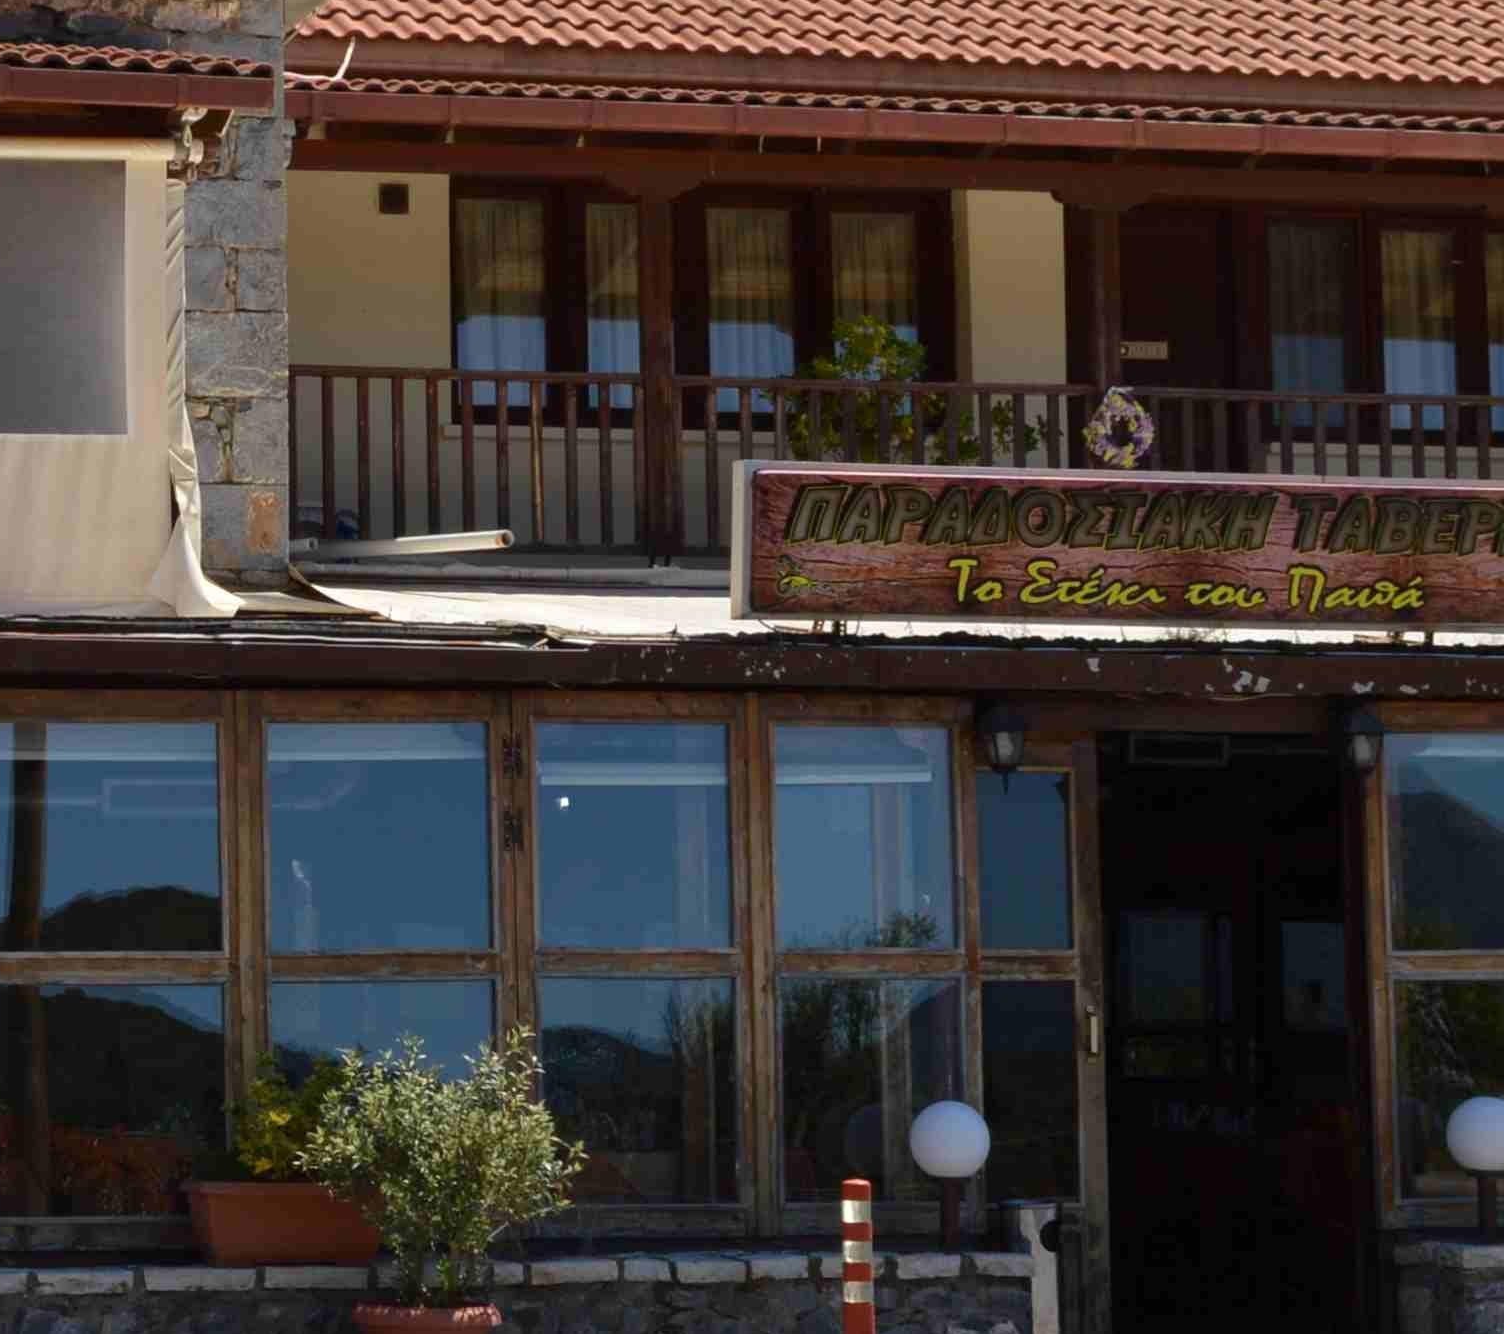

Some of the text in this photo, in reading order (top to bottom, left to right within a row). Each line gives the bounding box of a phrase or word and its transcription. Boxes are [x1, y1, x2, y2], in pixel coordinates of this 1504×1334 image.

[788, 483, 1278, 551] ΠΑΡΑΔΟΣΙΑΚΗ
[948, 558, 1004, 603] Το
[1183, 581, 1266, 608] του
[1289, 565, 1425, 613] Παπά
